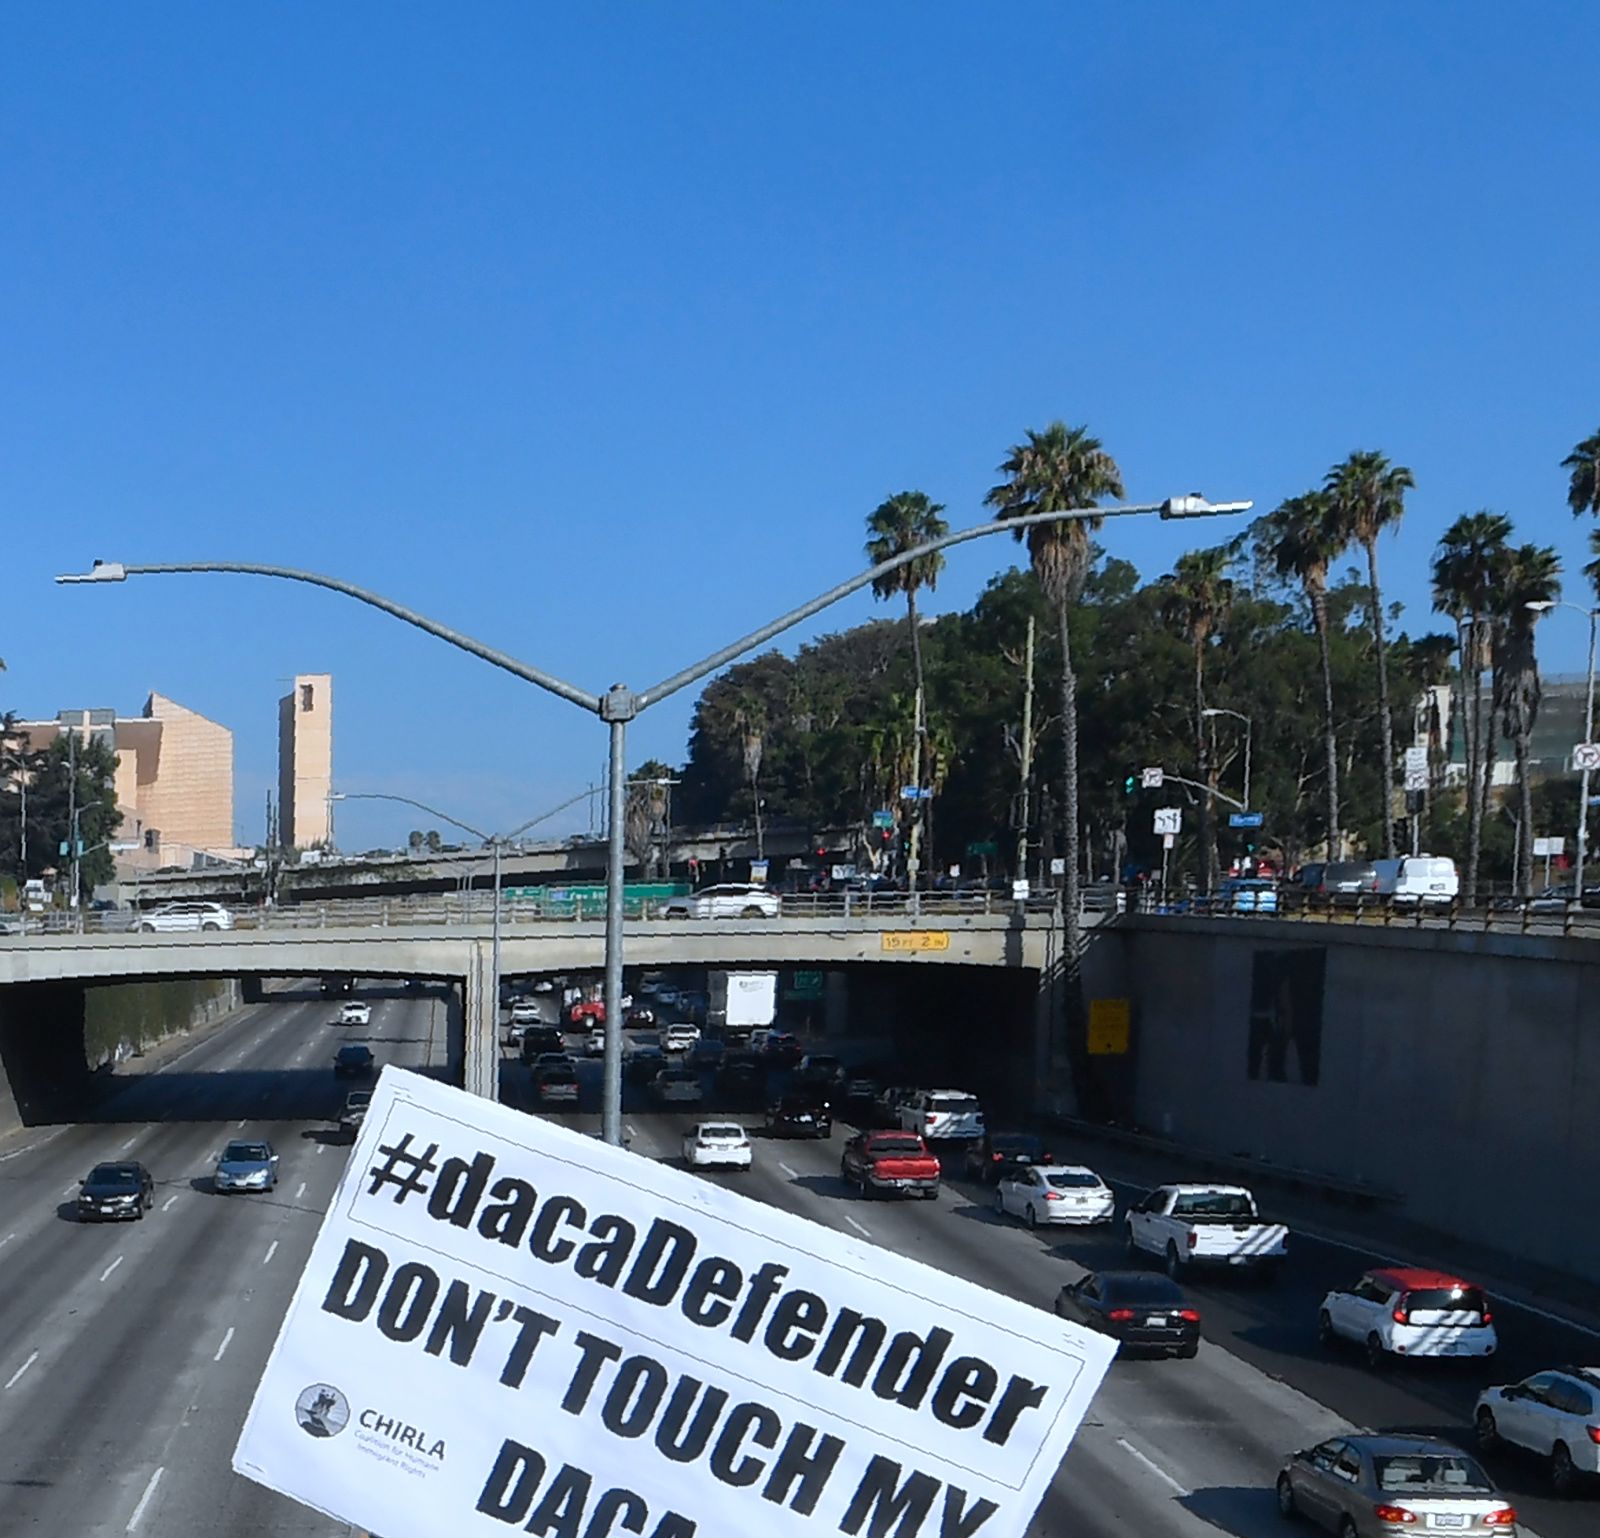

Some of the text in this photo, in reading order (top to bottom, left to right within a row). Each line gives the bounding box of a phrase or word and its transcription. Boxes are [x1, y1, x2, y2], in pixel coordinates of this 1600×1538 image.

[885, 936, 900, 947] 15
[921, 936, 930, 947] 2
[368, 1132, 1048, 1446] #dacaDefender
[322, 1238, 561, 1389] DON'T
[562, 1330, 845, 1516] TOUCH
[359, 1408, 445, 1461] CHIRLA
